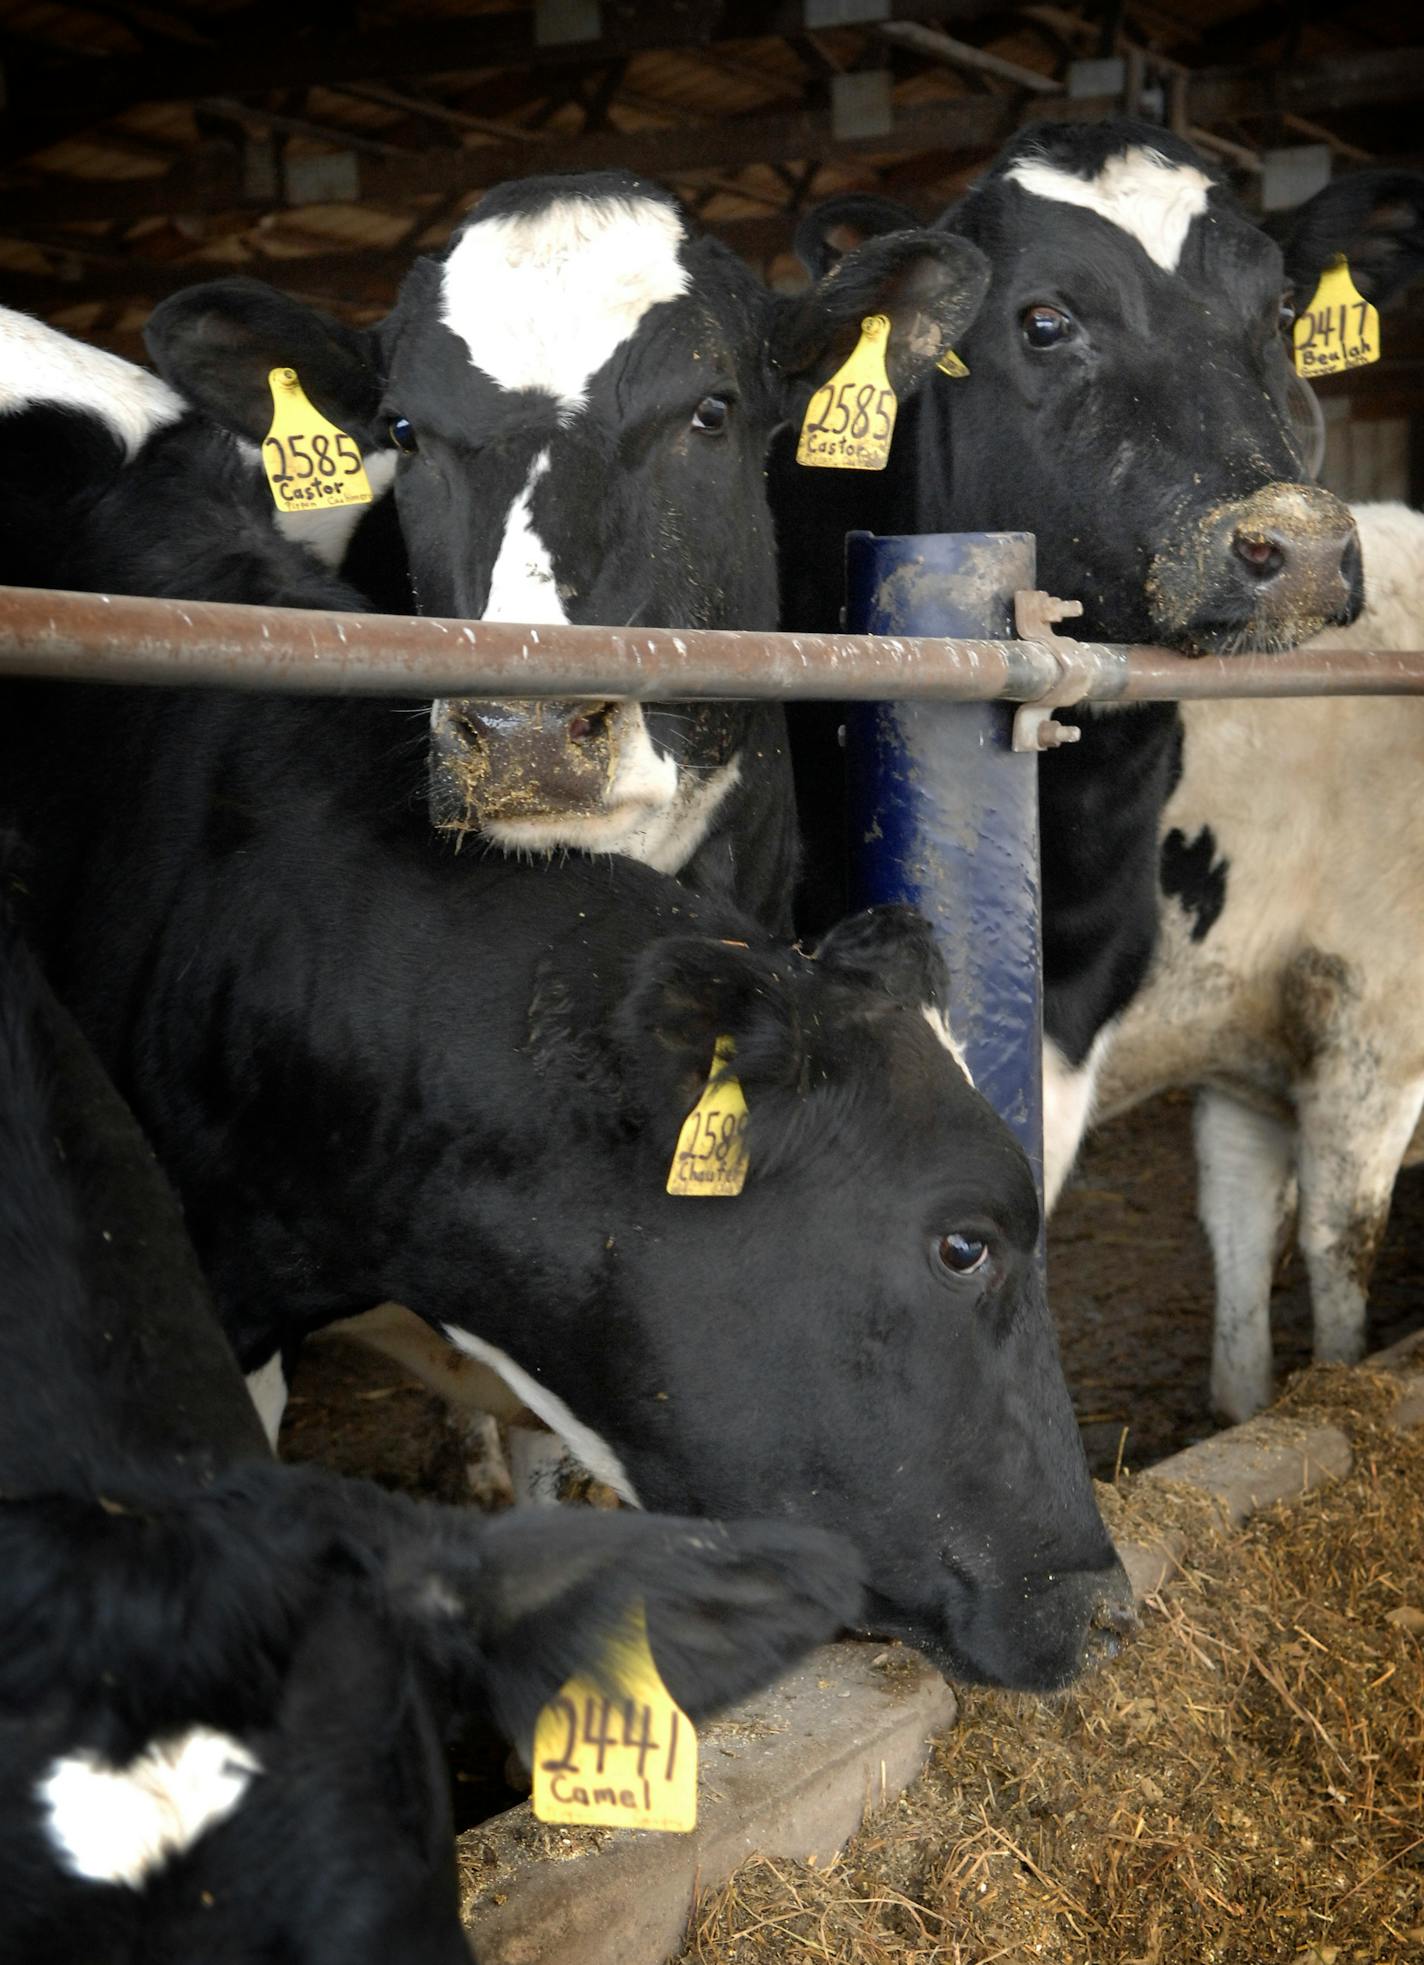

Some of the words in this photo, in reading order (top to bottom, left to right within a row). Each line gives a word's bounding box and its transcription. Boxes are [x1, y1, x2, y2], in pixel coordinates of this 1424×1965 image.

[1296, 301, 1368, 350] 2417
[1303, 336, 1371, 366] Beulah
[808, 383, 890, 440] 2585
[266, 434, 362, 483] 2585
[280, 477, 344, 501] Castor
[541, 1696, 679, 1782] 2441
[551, 1774, 651, 1811] Camel
